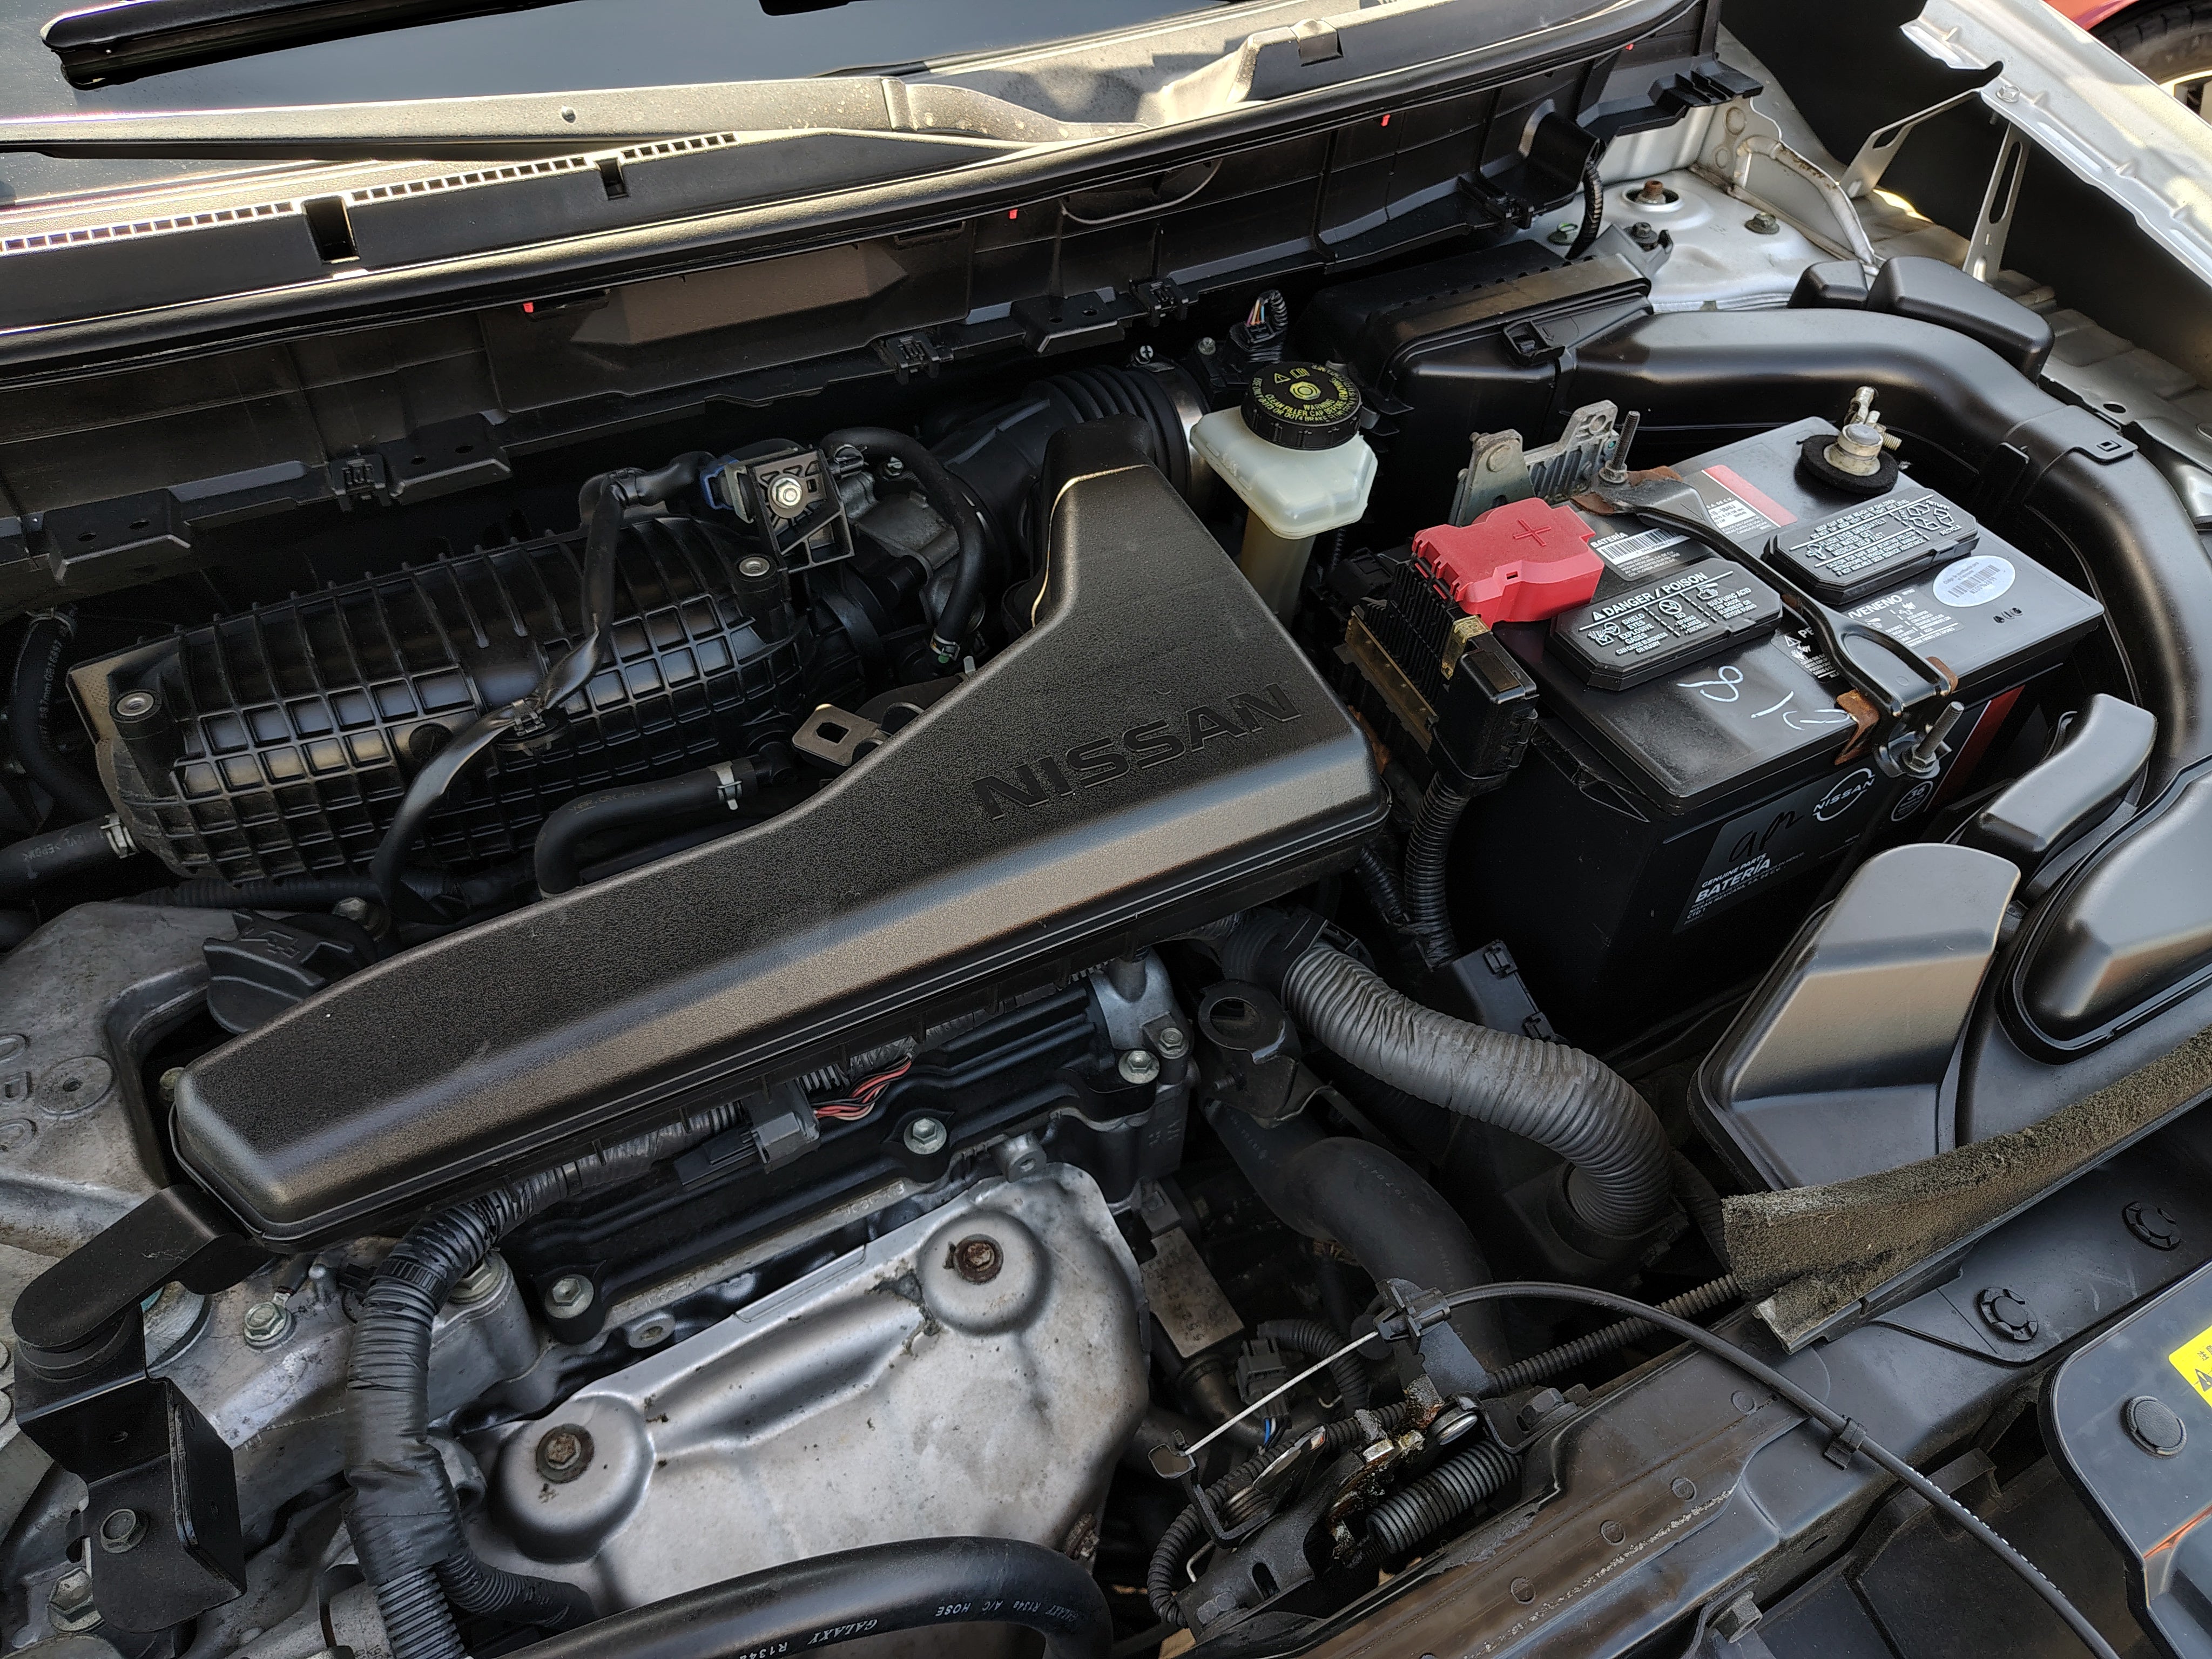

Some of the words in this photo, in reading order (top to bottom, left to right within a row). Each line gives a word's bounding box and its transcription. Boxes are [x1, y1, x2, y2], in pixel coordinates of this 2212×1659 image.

[1265, 394, 1285, 409] CLEAN
[1283, 406, 1307, 416] FILLER
[1324, 400, 1346, 415] BEFORE
[1272, 407, 1284, 416] OR
[1303, 399, 1335, 410] WARNING
[1853, 509, 1869, 518] REACH
[1590, 532, 1628, 548] BATERÍA
[1819, 537, 1837, 547] FLUSH
[1837, 531, 1852, 541] EYES
[1851, 517, 1887, 535] IMMEDIATELY
[1825, 543, 1843, 552] WITH
[1840, 536, 1862, 547] WATER
[1860, 530, 1874, 538] GET
[1831, 545, 1858, 557] MEDICAL
[1855, 538, 1871, 548] HELP
[1870, 532, 1885, 542] FAST
[1603, 592, 1655, 616] DANGER
[1661, 572, 1709, 594] POISON
[1707, 593, 1738, 607] SULFURIC
[1736, 587, 1751, 597] ACID
[1724, 598, 1741, 607] CAUSE
[1621, 613, 1645, 625] SHIELD
[1626, 620, 1646, 630] EYES
[1618, 623, 1655, 640] EXPLOSIVE
[1624, 633, 1648, 644] GASES
[1615, 647, 1627, 655] CAN
[1627, 641, 1643, 652] CAUSE
[1642, 632, 1669, 646] BLINDNESS
[970, 682, 1302, 821] NISSAN
[1813, 778, 1876, 813] NISSAN
[1702, 866, 1740, 888] GENUINE
[1739, 853, 1768, 871] PARTS
[1694, 858, 1771, 903] BATERÍA
[1689, 900, 1712, 915] NISSAN
[935, 1602, 972, 1617] HOSE
[982, 1600, 1003, 1612] A/C
[1013, 1600, 1041, 1613] R134a
[807, 1619, 878, 1645] GALAXY
